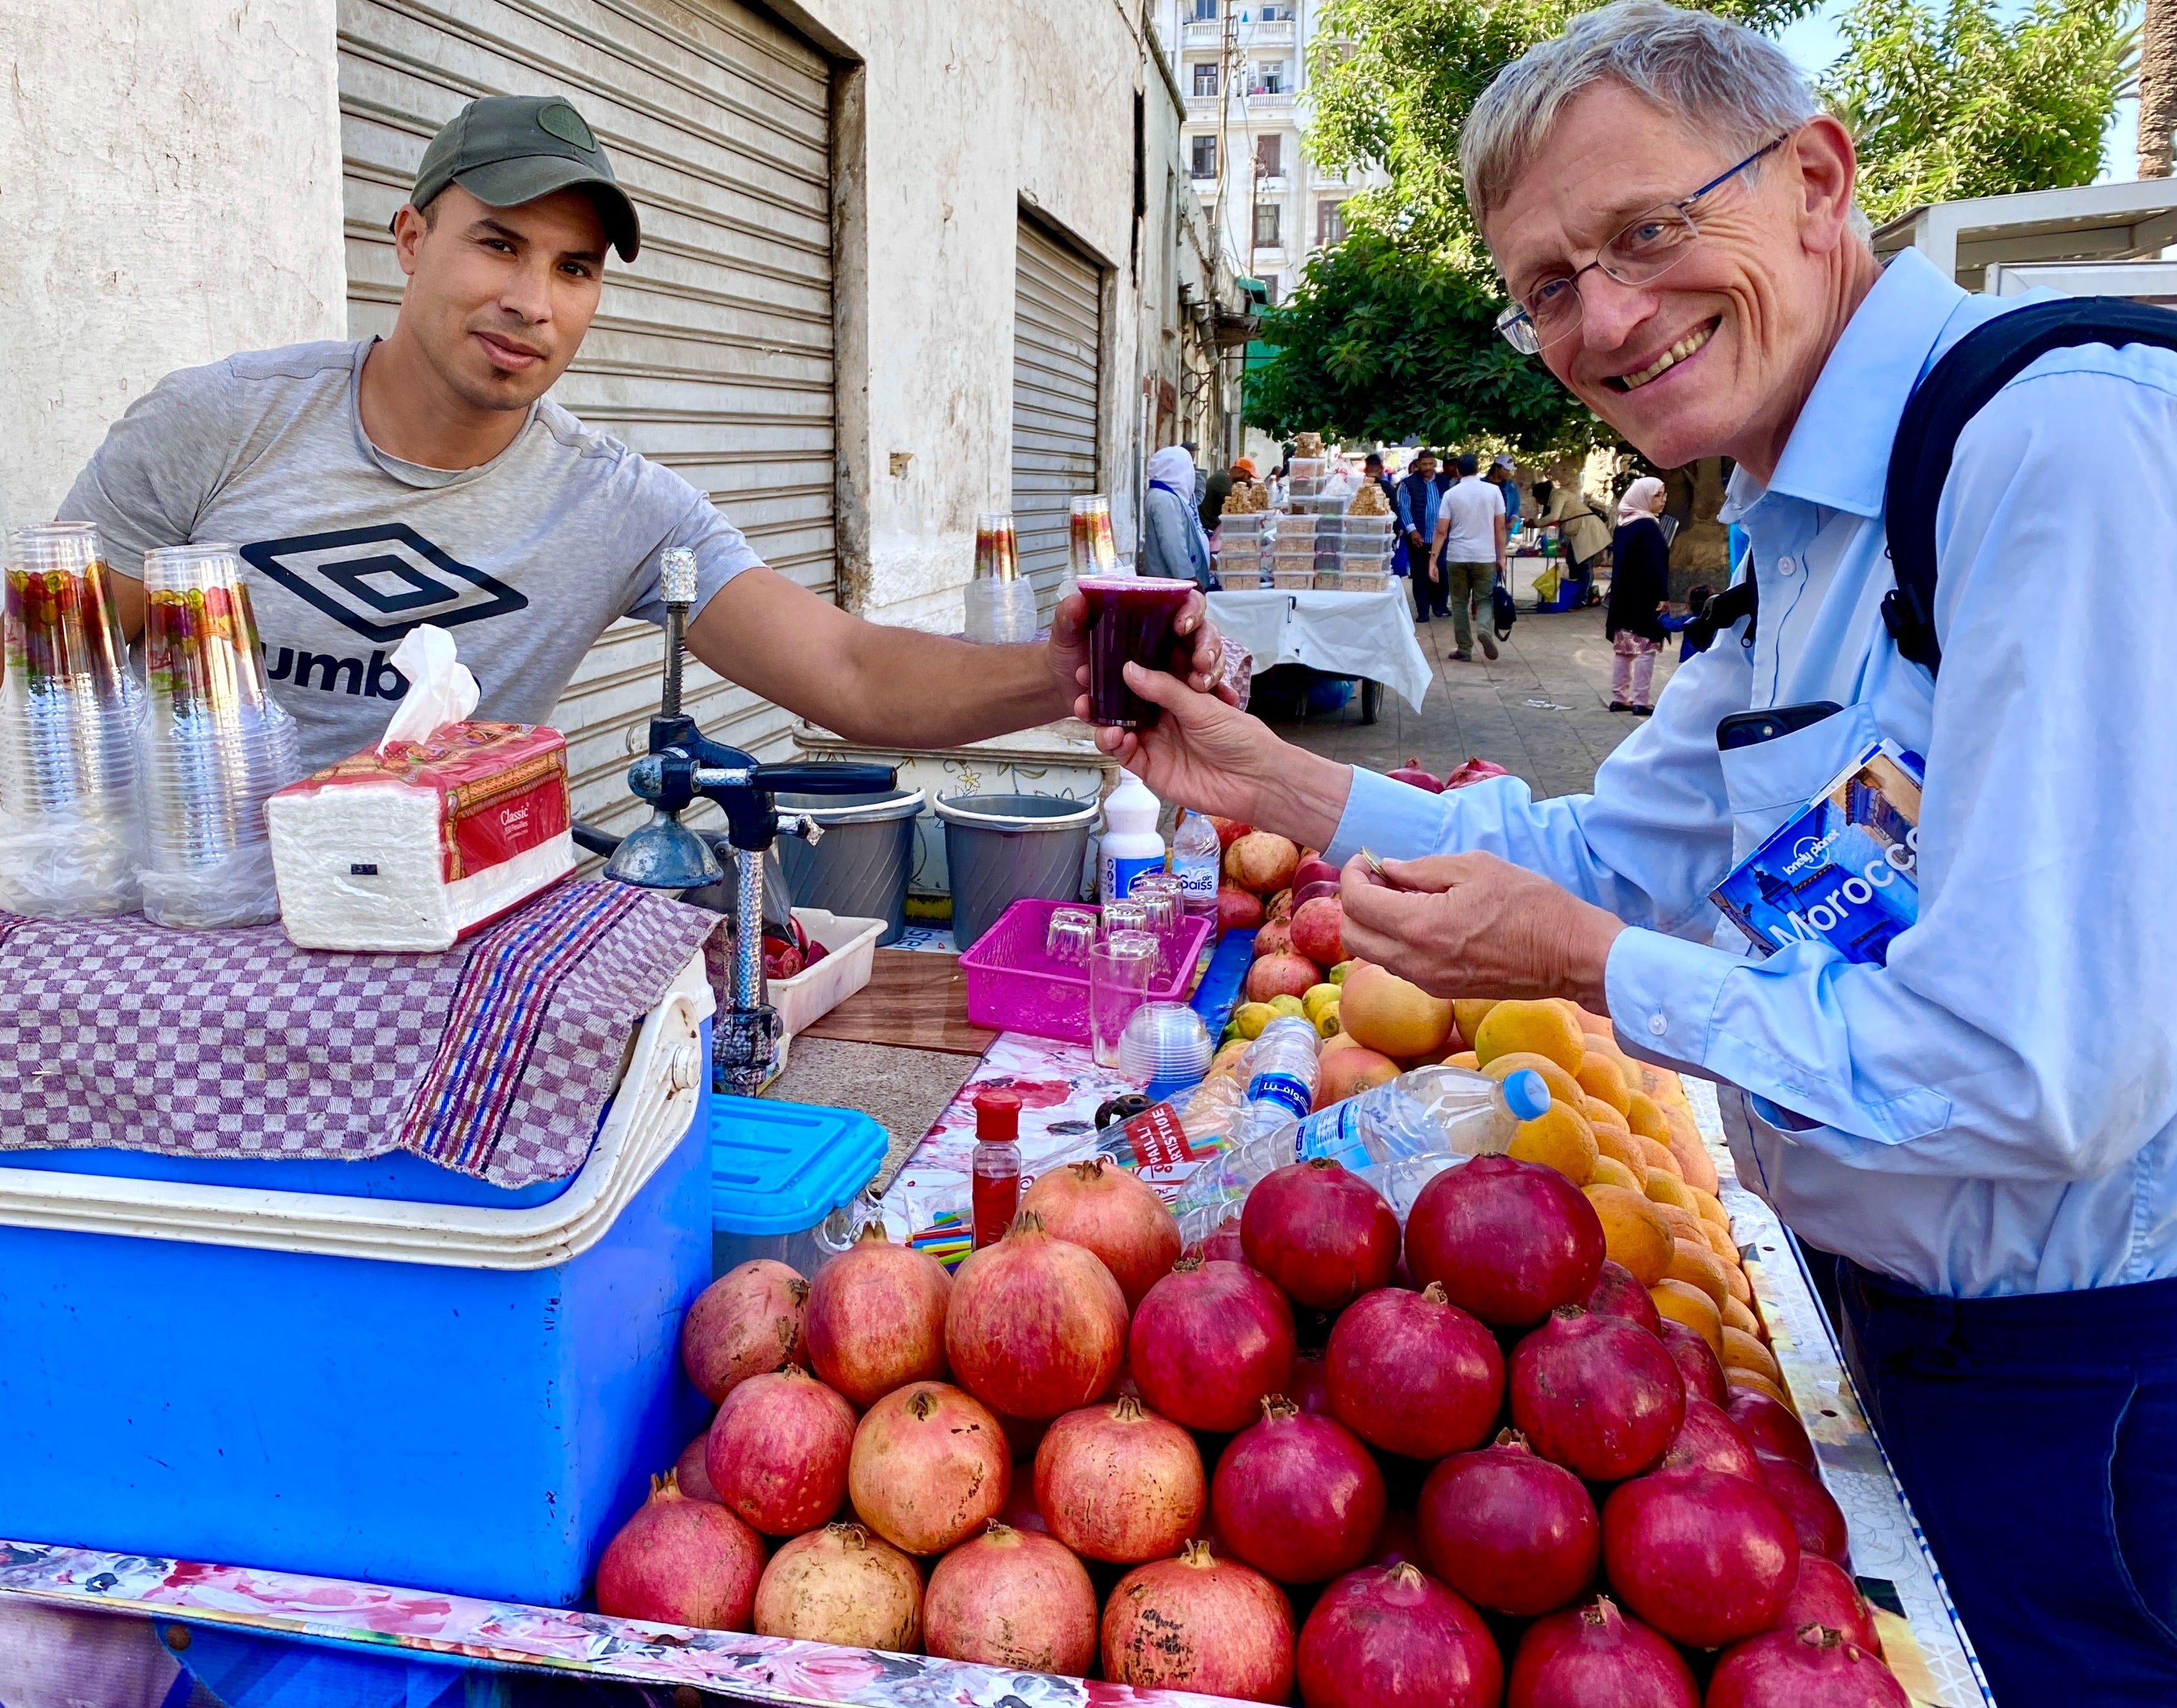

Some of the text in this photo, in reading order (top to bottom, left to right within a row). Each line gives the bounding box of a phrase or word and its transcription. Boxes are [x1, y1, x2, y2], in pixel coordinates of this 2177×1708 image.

[259, 641, 481, 701] umb
[501, 806, 529, 826] Classic
[1782, 828, 1840, 876] lonely planet
